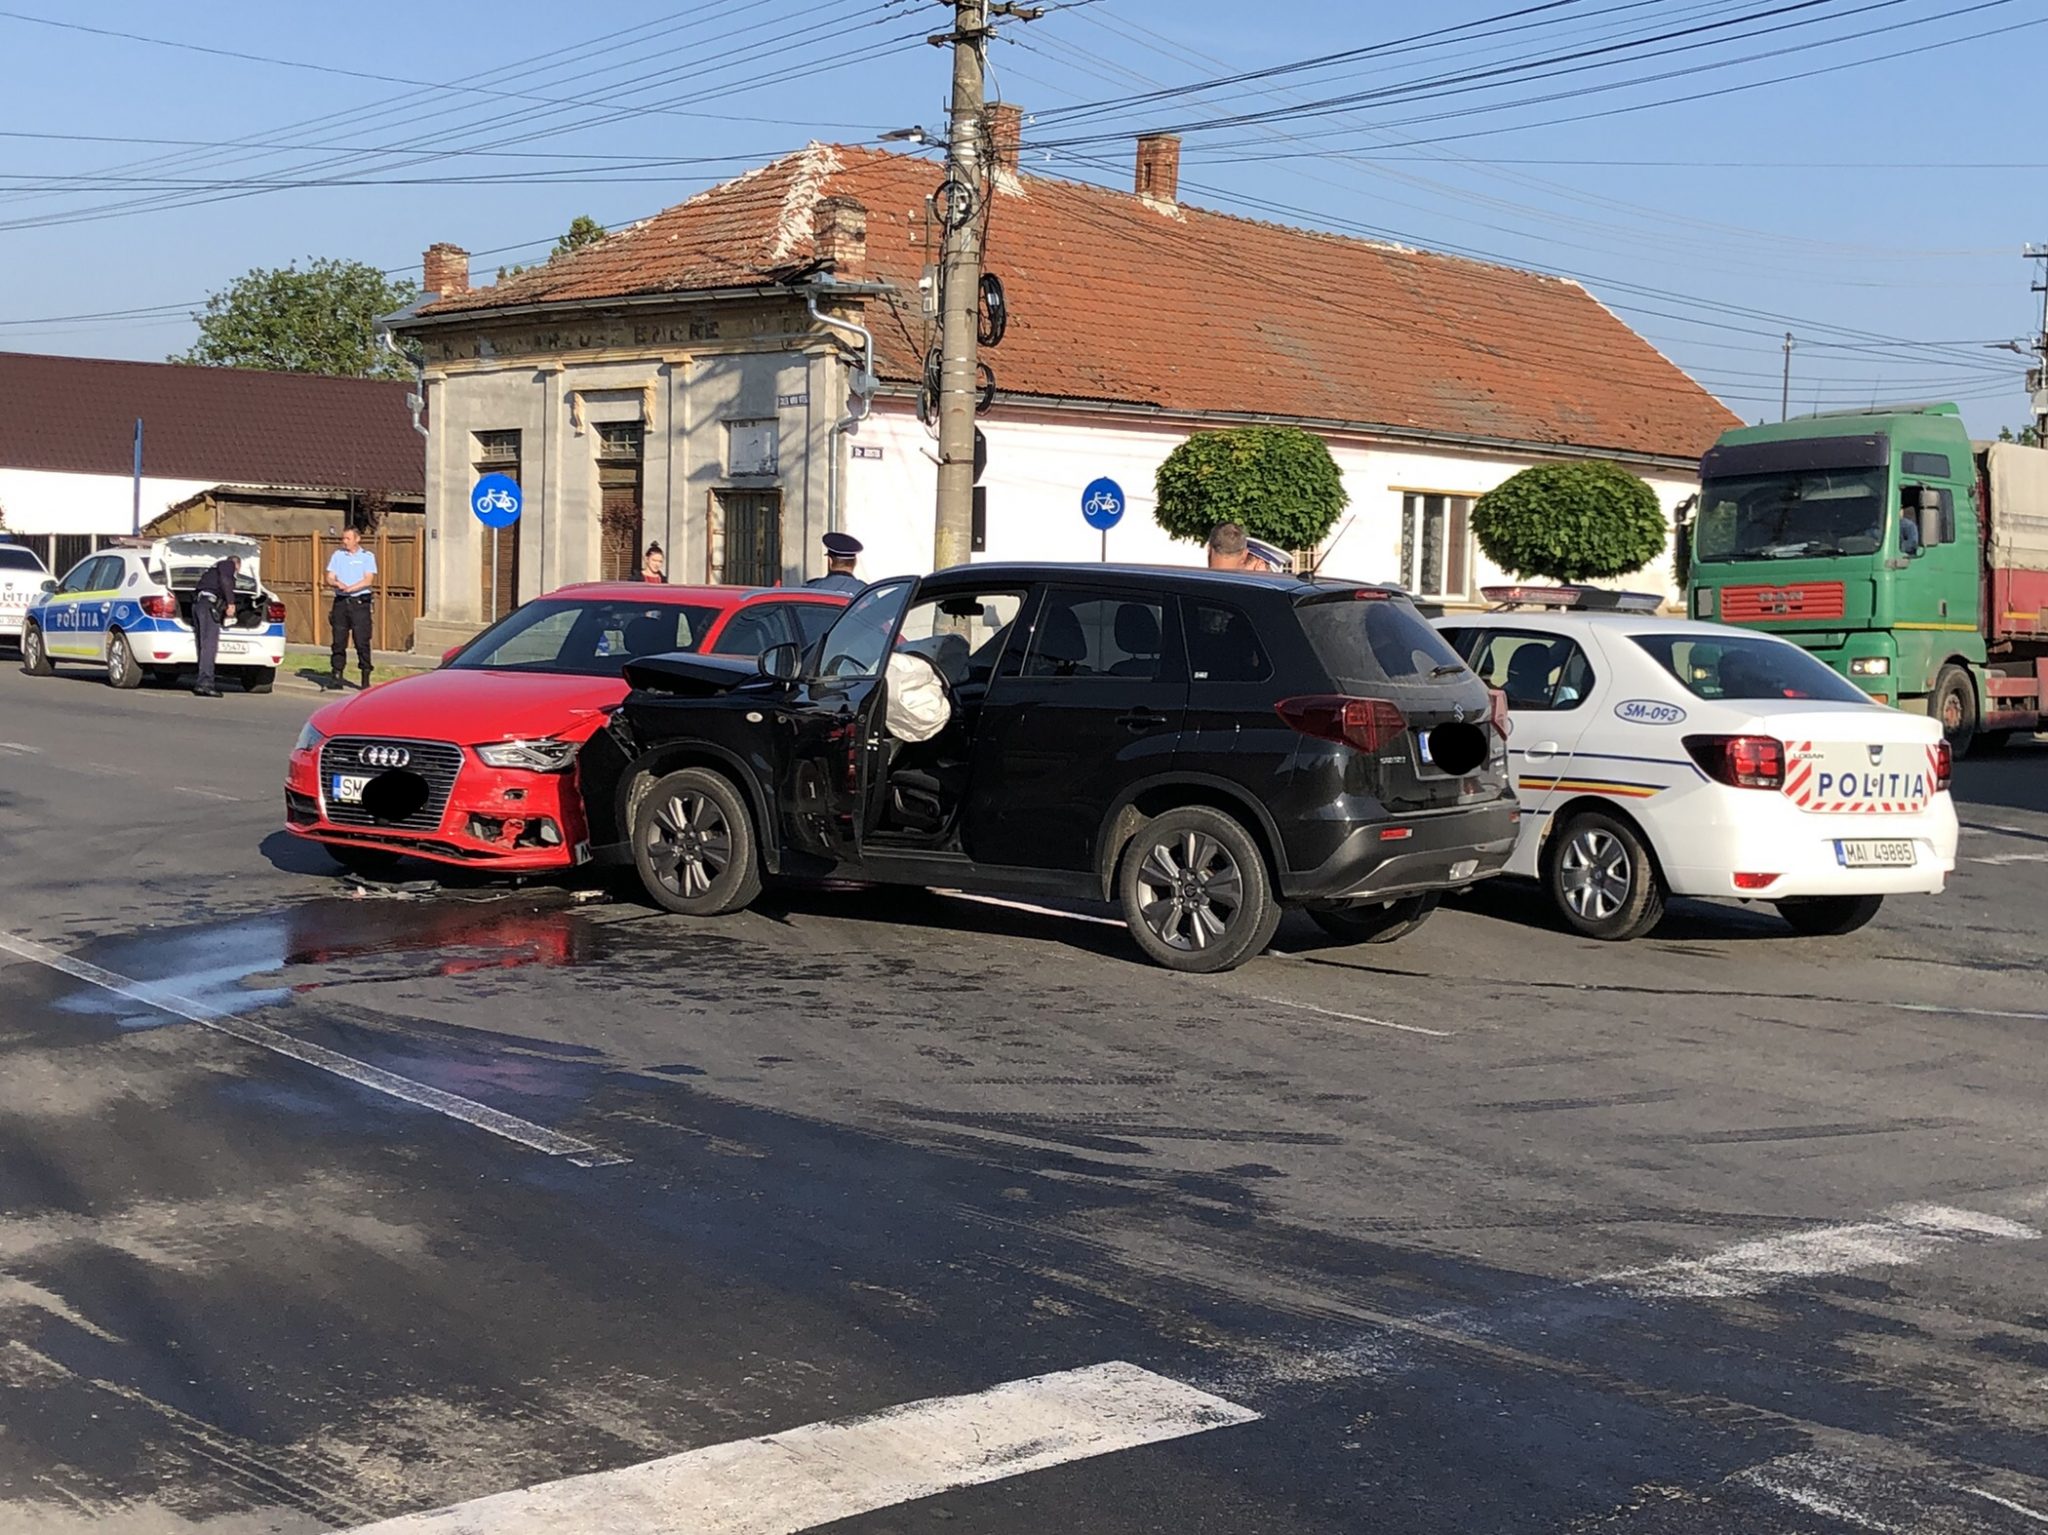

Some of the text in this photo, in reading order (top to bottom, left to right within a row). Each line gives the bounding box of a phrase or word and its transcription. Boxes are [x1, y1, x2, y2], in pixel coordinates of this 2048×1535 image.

[1624, 703, 1679, 721] SM-093
[1845, 843, 1912, 861] MAI 49885
